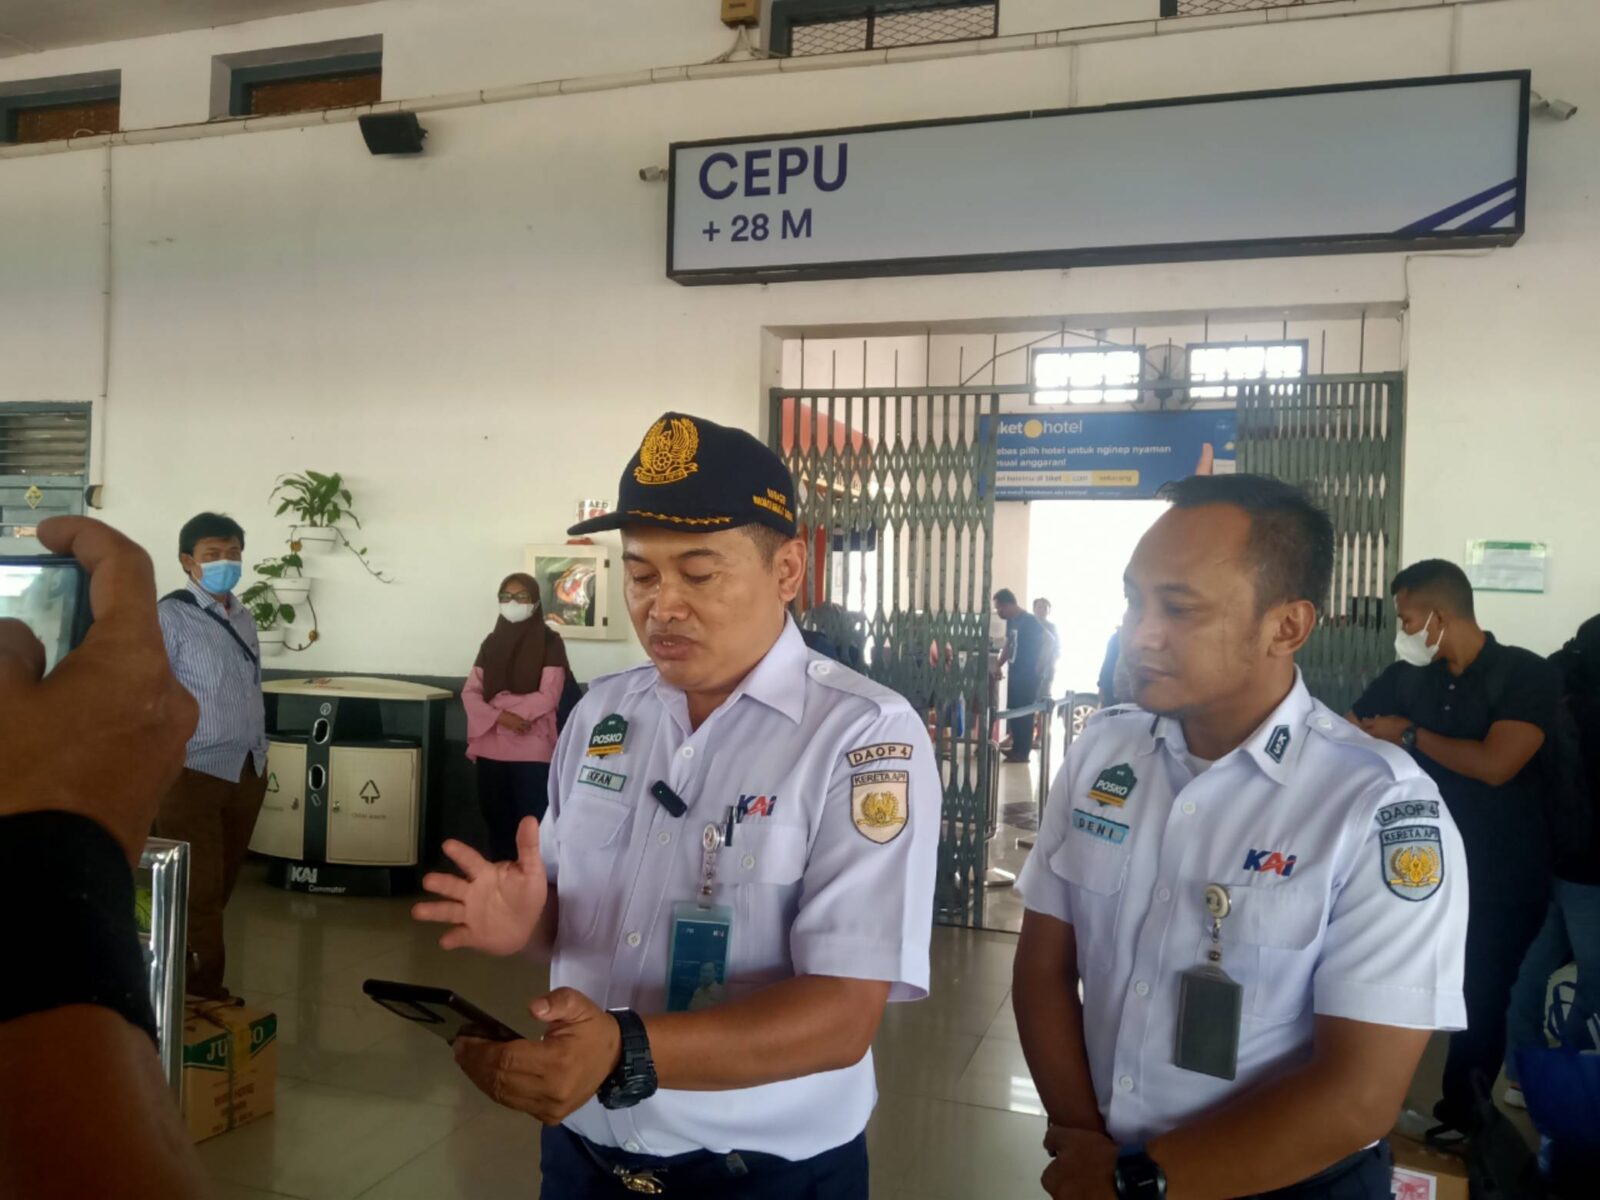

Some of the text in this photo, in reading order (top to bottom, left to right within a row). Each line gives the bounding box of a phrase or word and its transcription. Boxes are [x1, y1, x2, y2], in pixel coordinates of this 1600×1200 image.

[698, 142, 848, 200] CEPU
[702, 208, 812, 242] + 28 M
[1043, 420, 1083, 434] hotel
[1041, 445, 1065, 455] hotel
[1067, 445, 1094, 455] untuk
[1096, 445, 1131, 456] nginep
[1132, 444, 1172, 456] nyaman
[592, 732, 623, 745] POSKO
[853, 746, 908, 763] DAOP 4
[854, 773, 890, 785] KERETA
[1095, 779, 1128, 796] POSKO
[1380, 804, 1425, 822] DAOP
[1078, 817, 1114, 839] DENI
[1384, 829, 1423, 842] KERETA
[1242, 849, 1297, 877] KAI
[290, 866, 318, 884] KAI
